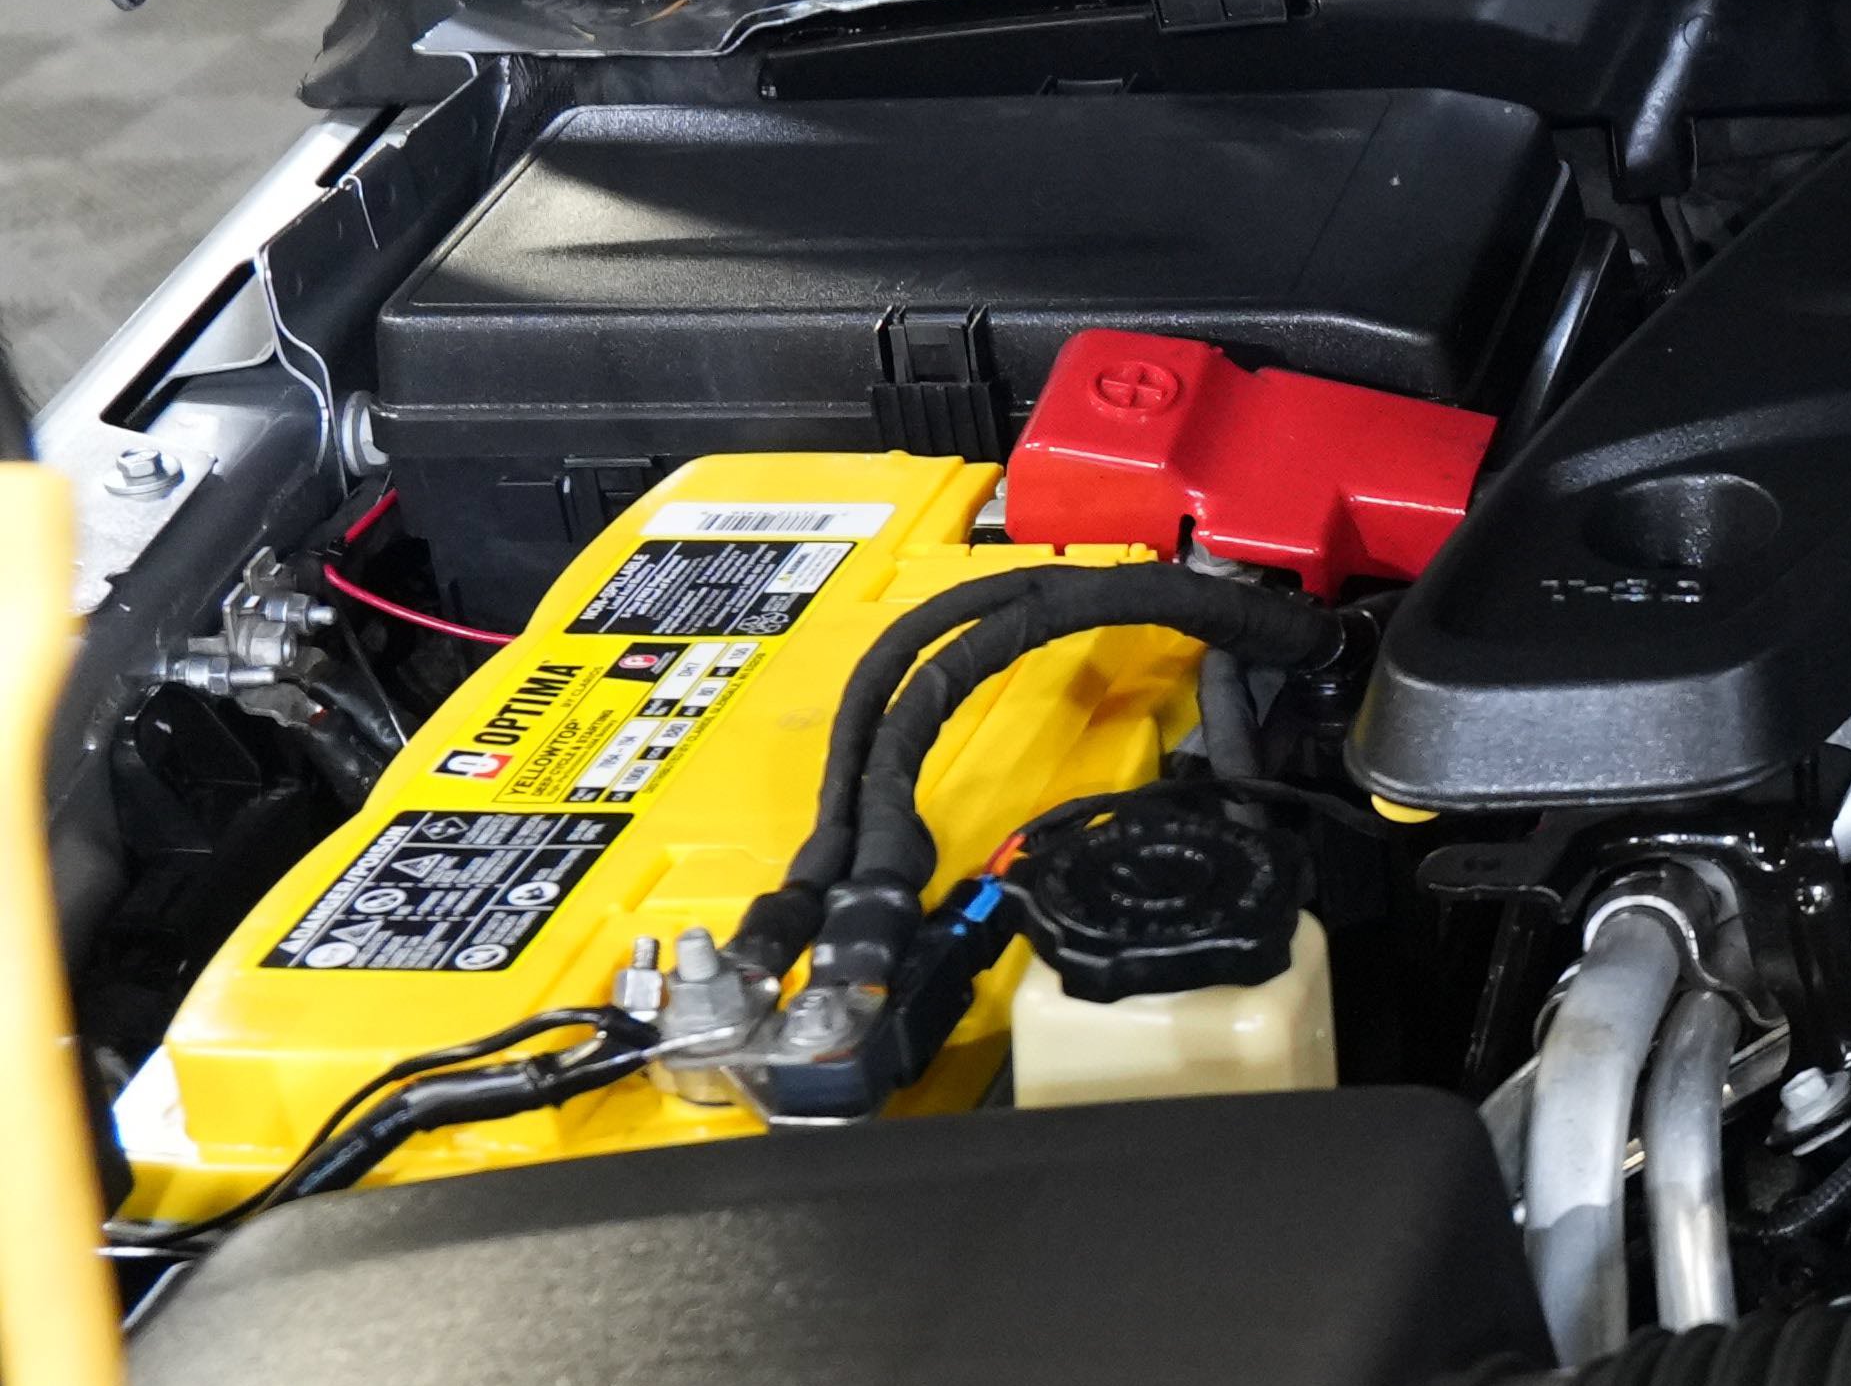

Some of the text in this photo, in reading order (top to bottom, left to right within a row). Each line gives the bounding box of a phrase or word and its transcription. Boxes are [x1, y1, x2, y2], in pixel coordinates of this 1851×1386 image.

[578, 553, 651, 619] NON-SPILLABLE
[473, 664, 585, 746] OPTIMA
[508, 721, 582, 795] YELLOWTOP
[286, 825, 412, 939] DANGER/POISON
